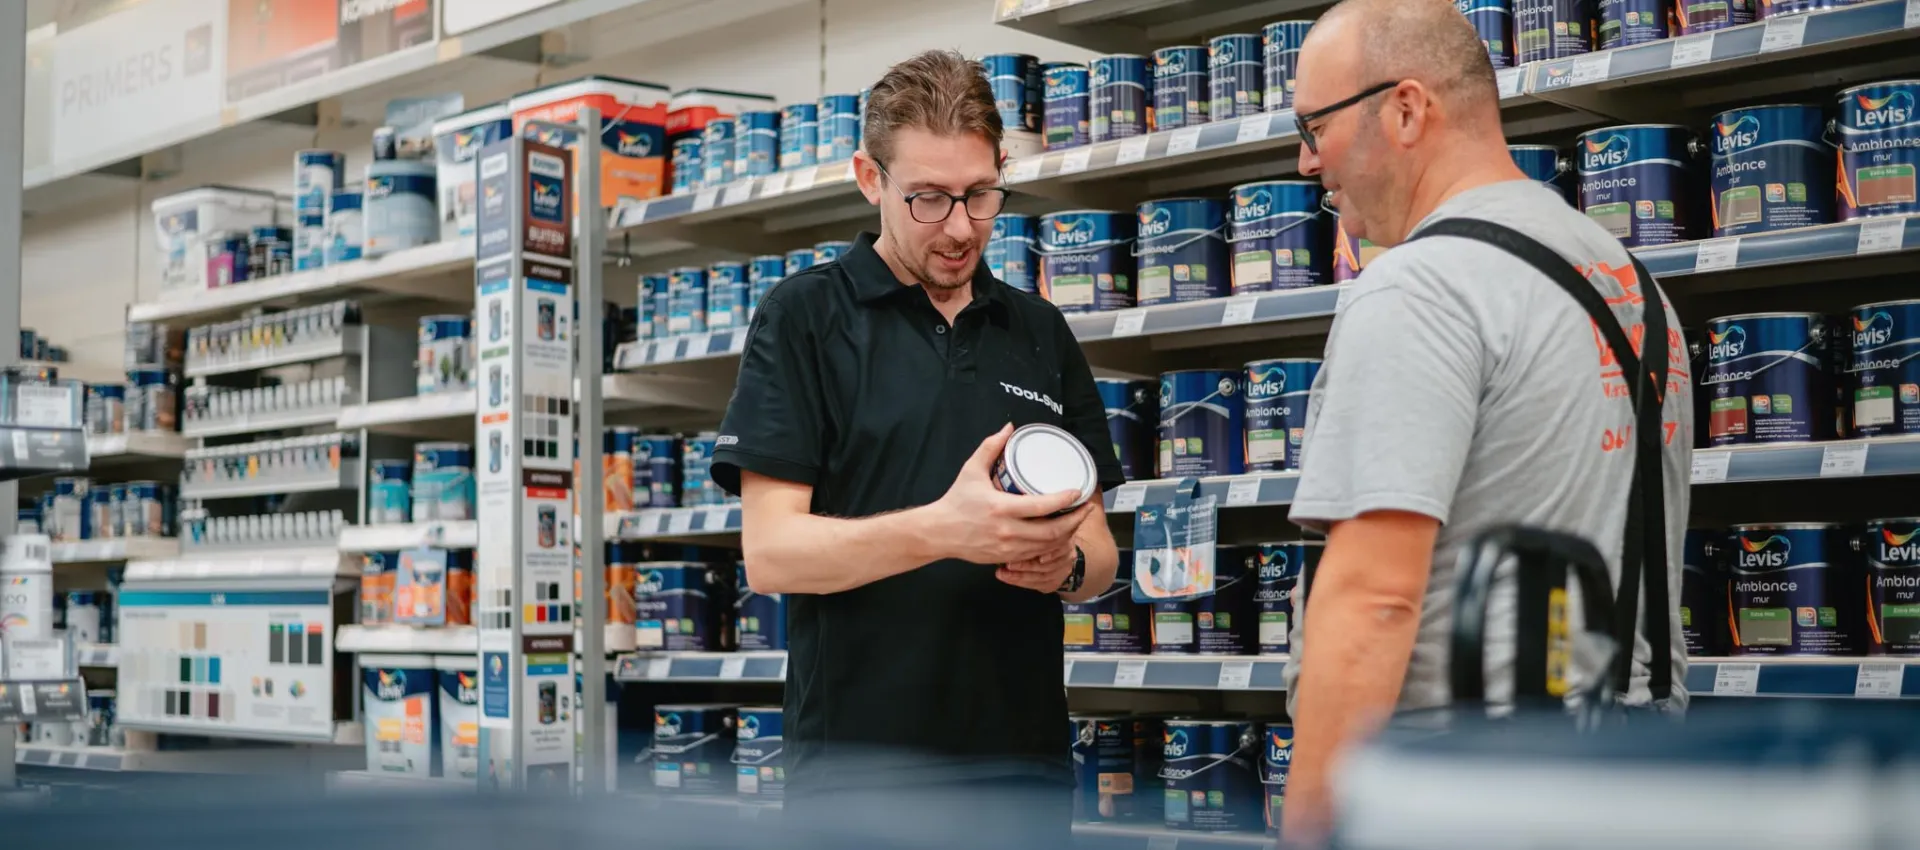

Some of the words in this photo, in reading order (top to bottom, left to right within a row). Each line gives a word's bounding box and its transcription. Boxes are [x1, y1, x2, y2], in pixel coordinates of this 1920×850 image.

[61, 45, 173, 116] PRIMERS
[1856, 104, 1907, 127] Levis
[1717, 131, 1753, 152] Levis
[1851, 136, 1920, 152] Ambiance
[1584, 149, 1622, 169] Levis
[1873, 153, 1893, 163] mur
[1715, 159, 1767, 178] Ambiance
[1582, 176, 1637, 193] Ambiance
[1596, 192, 1612, 201] mur
[1235, 203, 1266, 219] Levis
[1138, 221, 1165, 237] Levis
[1051, 230, 1088, 245] Levis
[1853, 329, 1885, 348] Levis
[1709, 341, 1738, 360] Levis
[1248, 380, 1279, 397] Levis
[1246, 406, 1291, 418] Ambiance
[1739, 550, 1783, 567] Levis
[1735, 580, 1797, 593] Ambiance
[1876, 574, 1920, 588] Ambian
[1753, 595, 1770, 604] mur
[1896, 591, 1915, 600] mur
[1271, 748, 1292, 762] Lev
